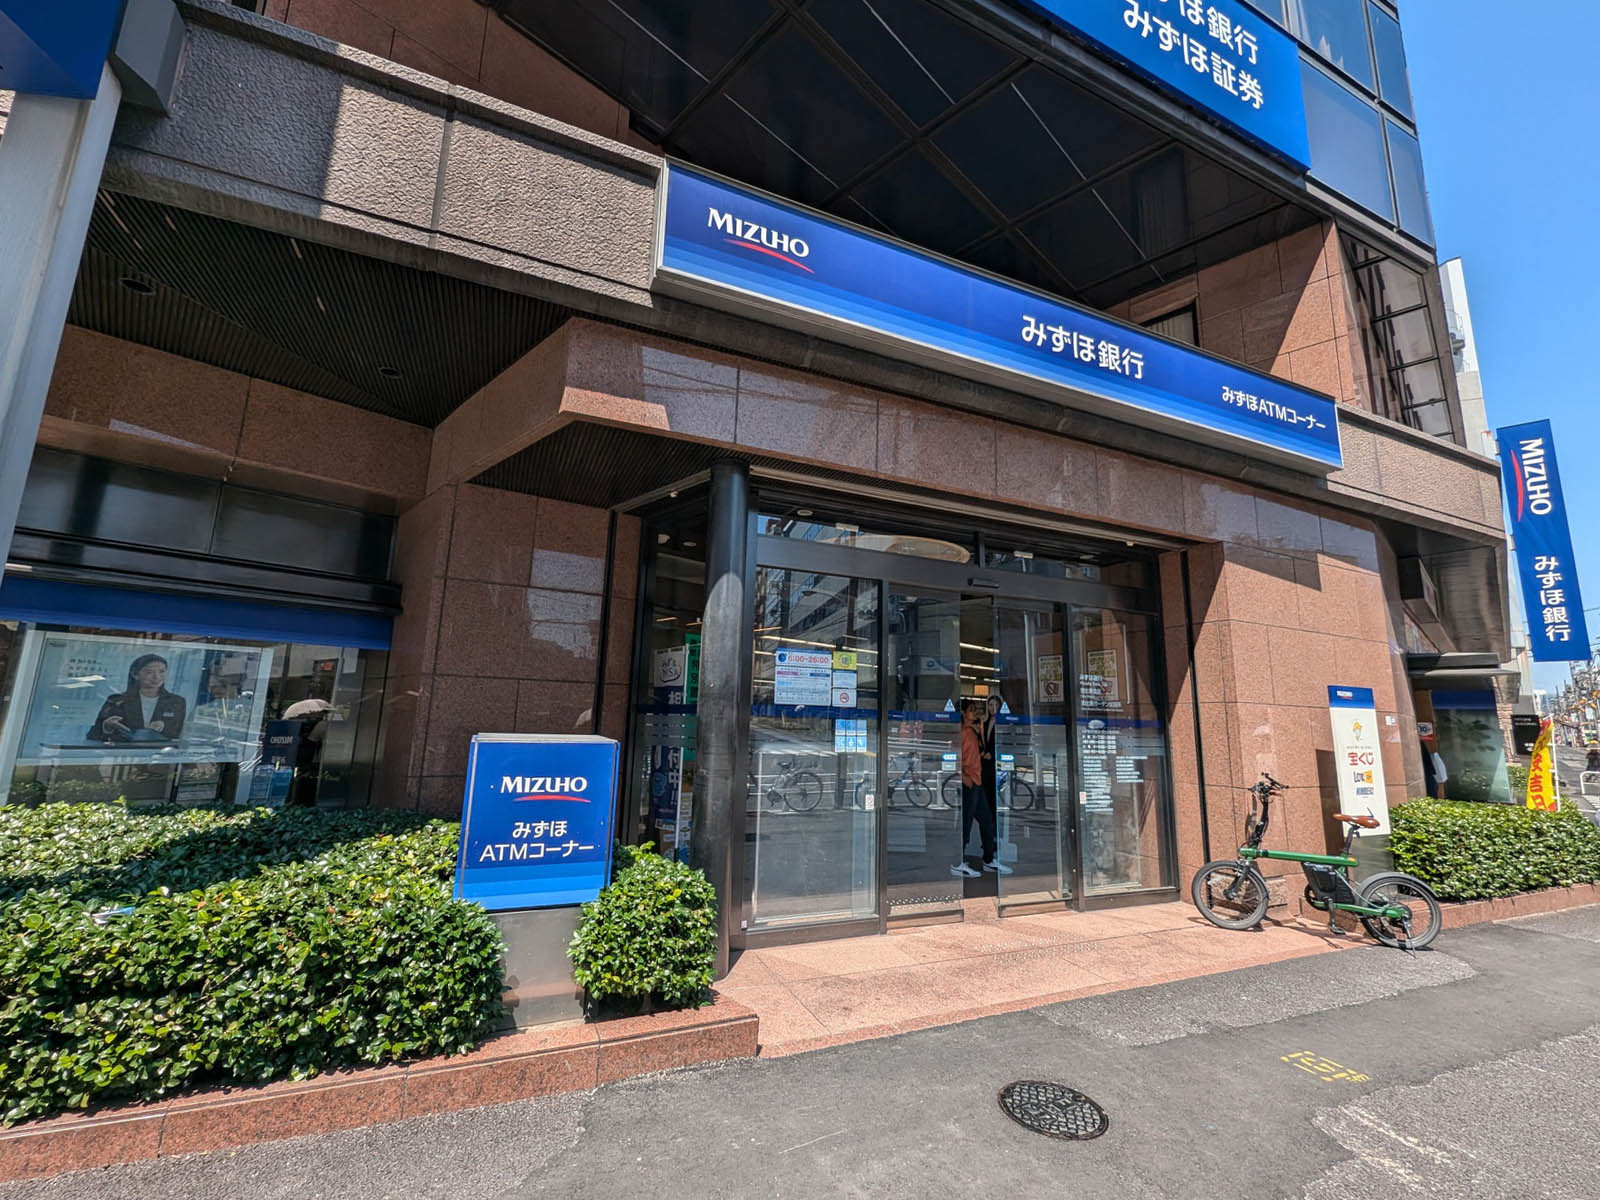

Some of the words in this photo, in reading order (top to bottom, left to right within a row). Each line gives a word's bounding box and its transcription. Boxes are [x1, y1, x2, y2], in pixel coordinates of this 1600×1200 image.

[1123, 0, 1264, 110] みずほ証券
[1157, 0, 1258, 64] ほ銀行
[707, 207, 810, 258] MIZUHO
[1021, 315, 1145, 380] みずほ銀行
[1221, 385, 1326, 430] みずほATMコーナー
[1519, 437, 1552, 515] MIZUHO
[1534, 555, 1571, 642] みずほ銀行
[500, 776, 588, 794] MIZUHO
[479, 840, 595, 863] ATMコーナー
[512, 820, 568, 838] みずほ
